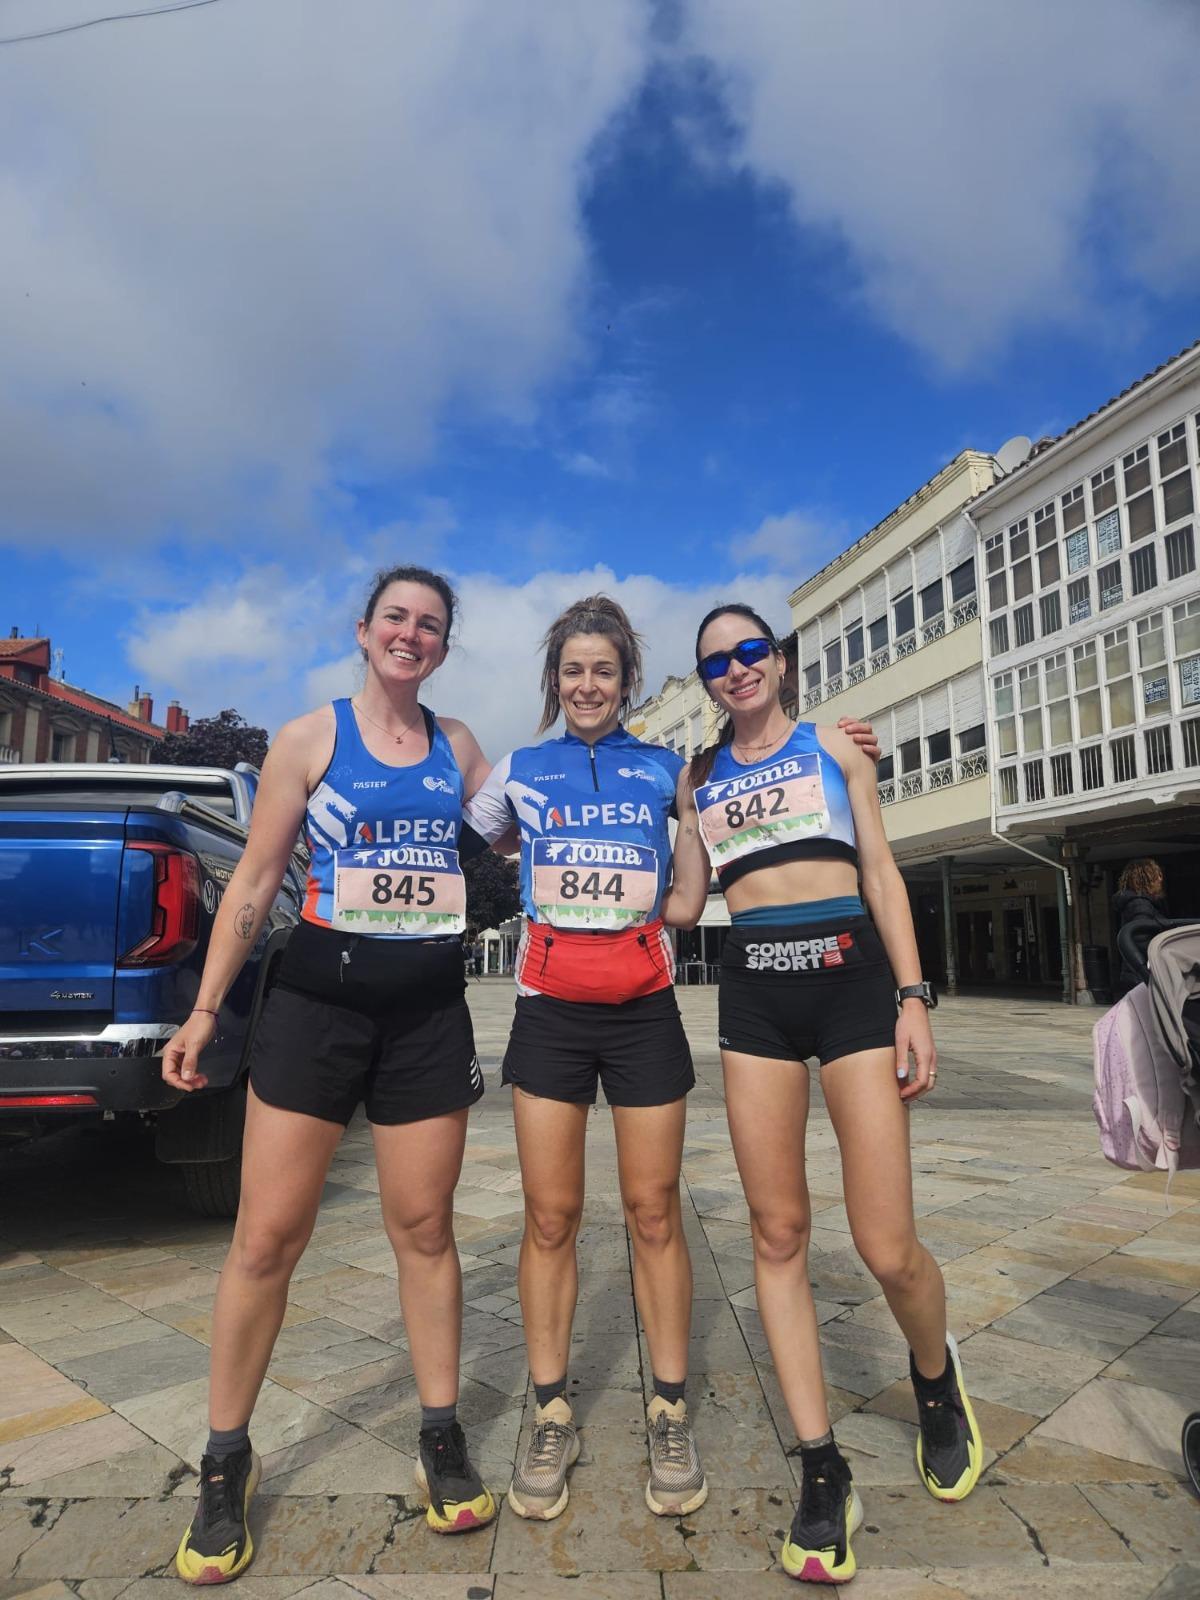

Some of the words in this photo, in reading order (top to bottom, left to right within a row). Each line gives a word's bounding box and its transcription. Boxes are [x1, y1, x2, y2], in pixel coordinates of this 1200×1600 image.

[353, 781, 387, 790] FASTER
[534, 774, 566, 782] FASTER
[726, 760, 802, 797] Joma
[545, 802, 653, 830] ALPESA
[724, 787, 789, 829] 842
[353, 818, 456, 844] ALPESA
[377, 847, 448, 869] Joma
[566, 843, 642, 866] Joma
[371, 873, 435, 906] 845
[560, 870, 625, 902] 844
[745, 953, 822, 971] SPORT
